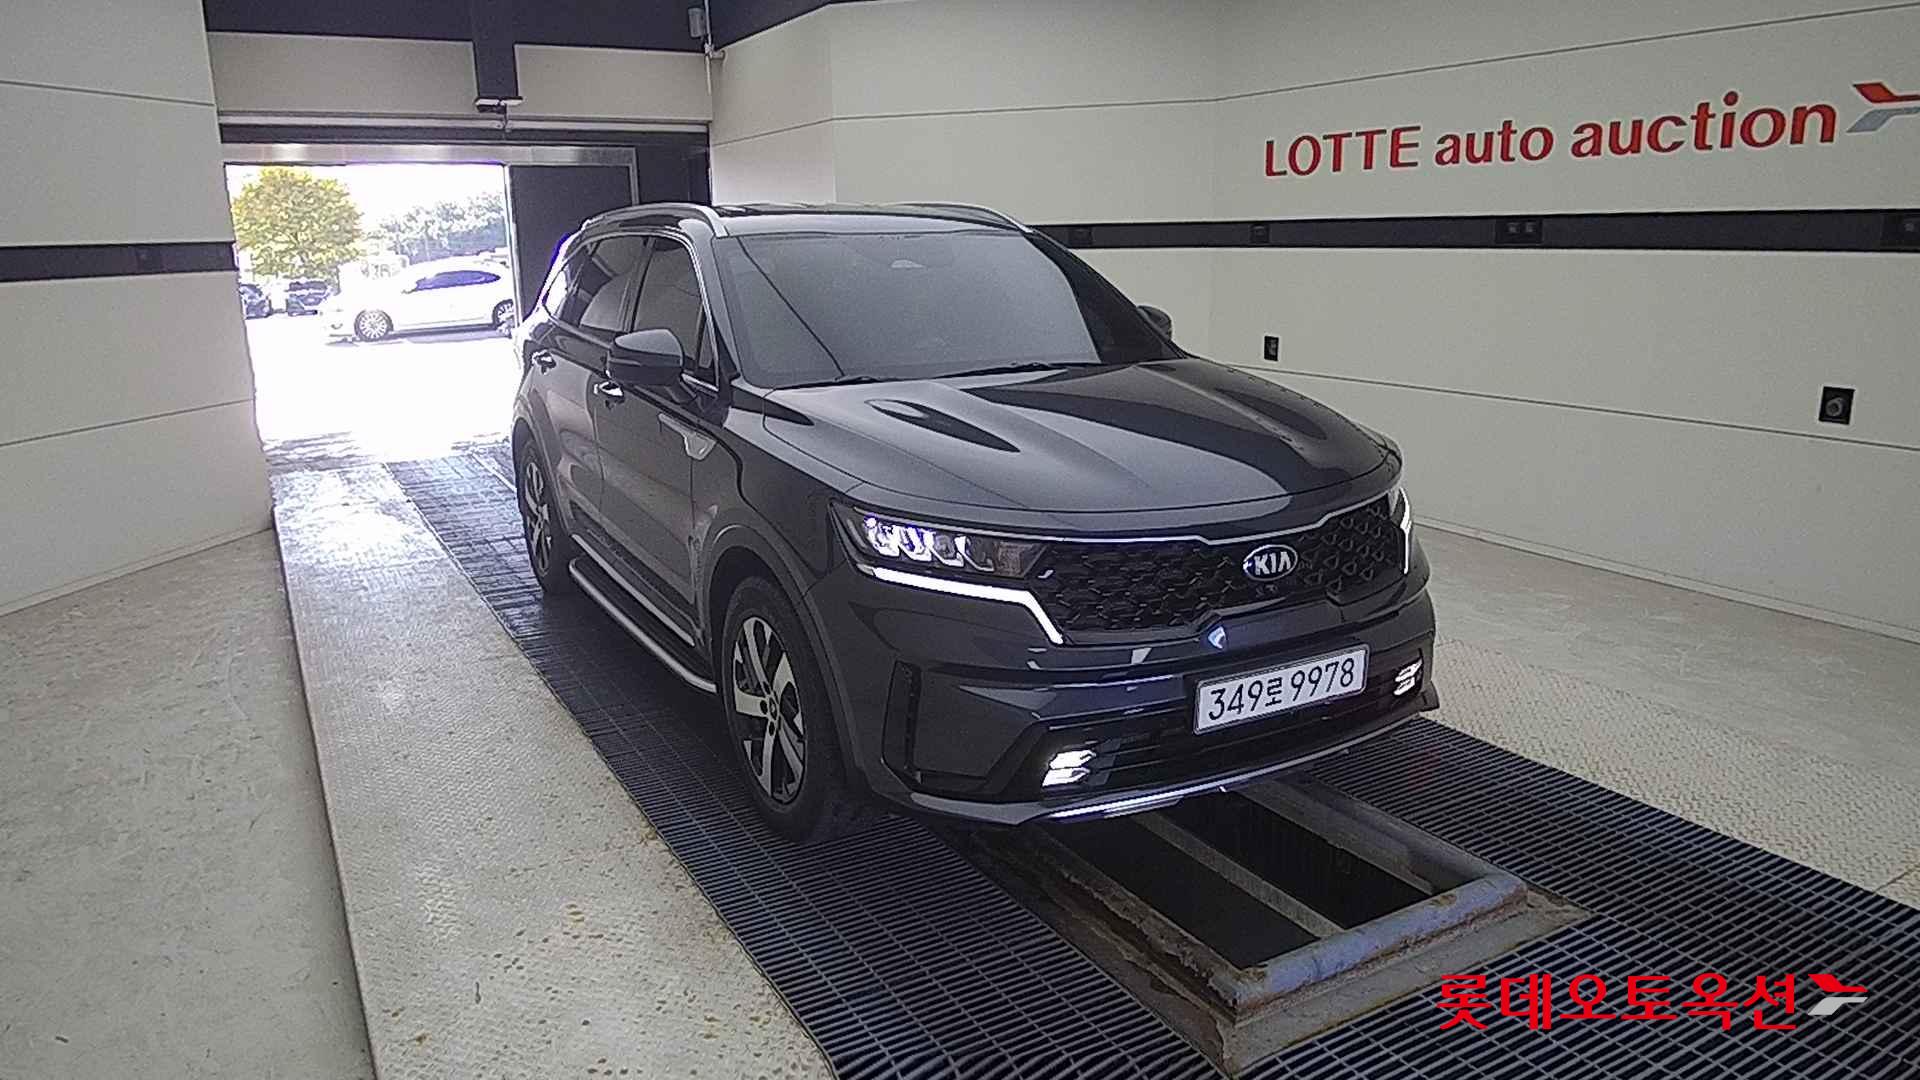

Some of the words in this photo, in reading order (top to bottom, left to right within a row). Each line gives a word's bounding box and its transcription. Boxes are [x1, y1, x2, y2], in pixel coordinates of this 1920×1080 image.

[1265, 126, 1421, 178] LOTTE
[1434, 120, 1555, 167] auto
[1571, 92, 1838, 158] auction
[1253, 551, 1292, 576] KIA
